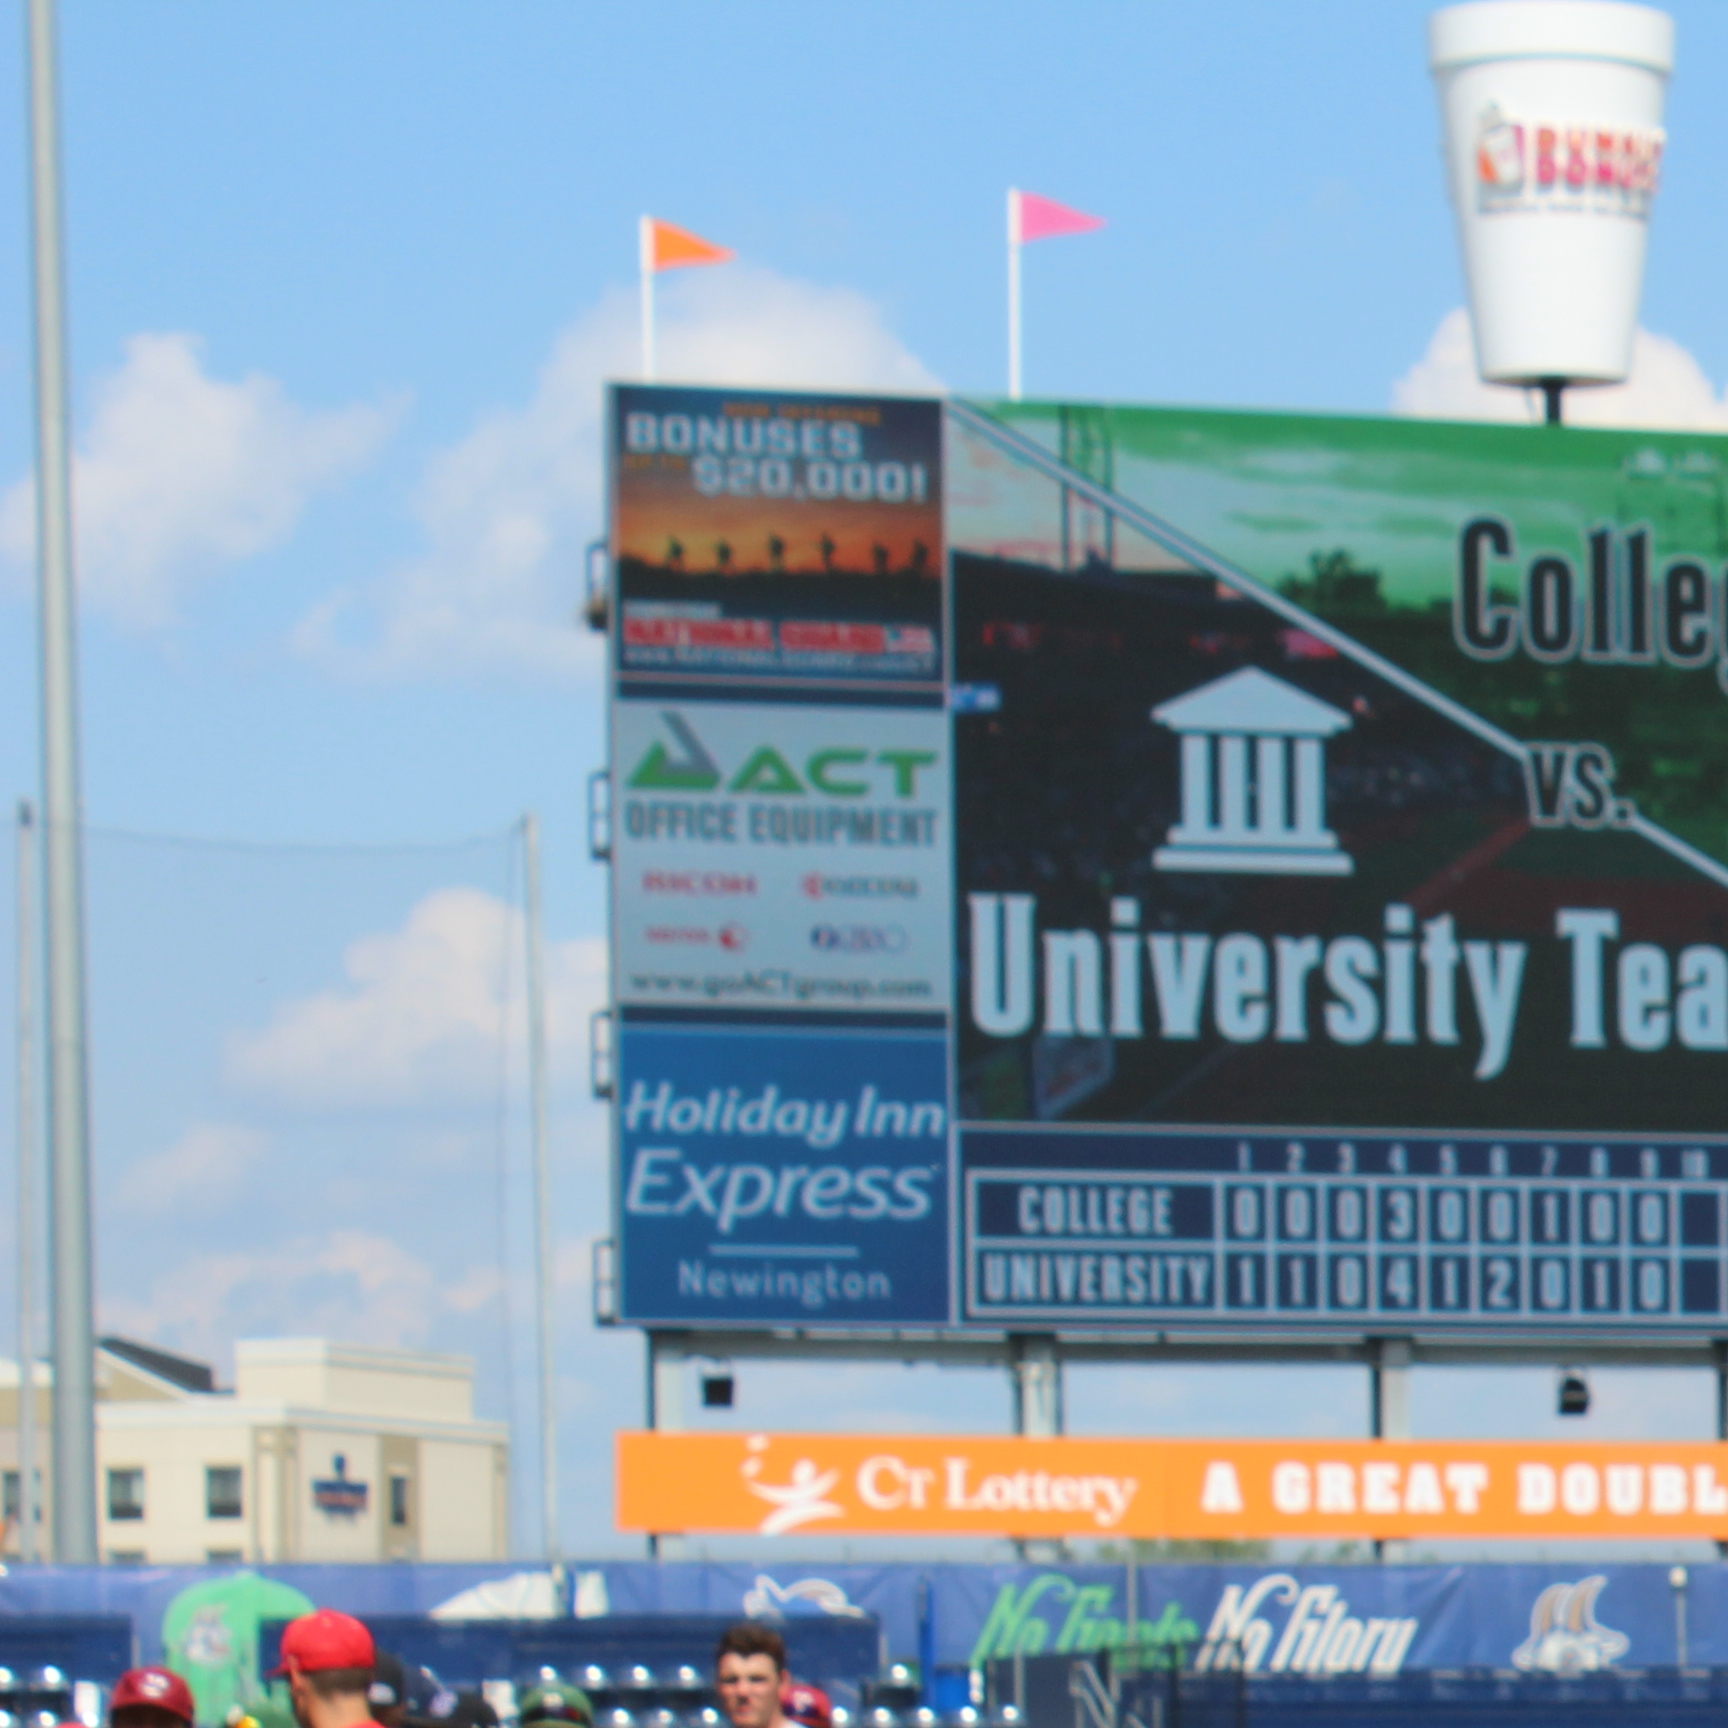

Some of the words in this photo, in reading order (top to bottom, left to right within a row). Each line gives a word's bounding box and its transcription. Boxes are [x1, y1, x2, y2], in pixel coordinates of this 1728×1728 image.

[626, 411, 863, 459] BONUSES
[692, 454, 928, 504] $20,000!
[726, 744, 939, 798] ACT
[625, 802, 738, 840] OFFICE
[750, 803, 937, 847] EQUIPMENT
[969, 893, 1528, 1081] University
[625, 1080, 848, 1148] Holiday
[854, 1084, 945, 1137] Inn
[625, 1147, 932, 1234] Express
[1018, 1185, 1172, 1235] COLLEGE
[1234, 1189, 1258, 1238] 0
[1285, 1189, 1310, 1238] 0
[1337, 1190, 1361, 1239] 0
[1388, 1190, 1412, 1239] 3
[1438, 1191, 1463, 1240] 0
[1488, 1192, 1513, 1242] 0
[1543, 1195, 1559, 1242] 1
[1589, 1193, 1613, 1243] 0
[1638, 1193, 1663, 1243] 0
[678, 1259, 892, 1311] Newington
[983, 1255, 1208, 1301] UNIVERSITY
[1238, 1259, 1256, 1305] 1
[1290, 1259, 1307, 1305] 1
[1337, 1258, 1362, 1306] 0
[1387, 1258, 1412, 1306] 4
[1442, 1260, 1458, 1307] 1
[1488, 1260, 1513, 1308] 2
[1540, 1260, 1564, 1309] 0
[1593, 1262, 1609, 1309] 1
[1639, 1261, 1664, 1311] 0
[943, 1459, 1140, 1526] Lottery
[1201, 1461, 1243, 1512] A
[1273, 1461, 1491, 1513] GREAT
[1195, 1573, 1299, 1672] No
